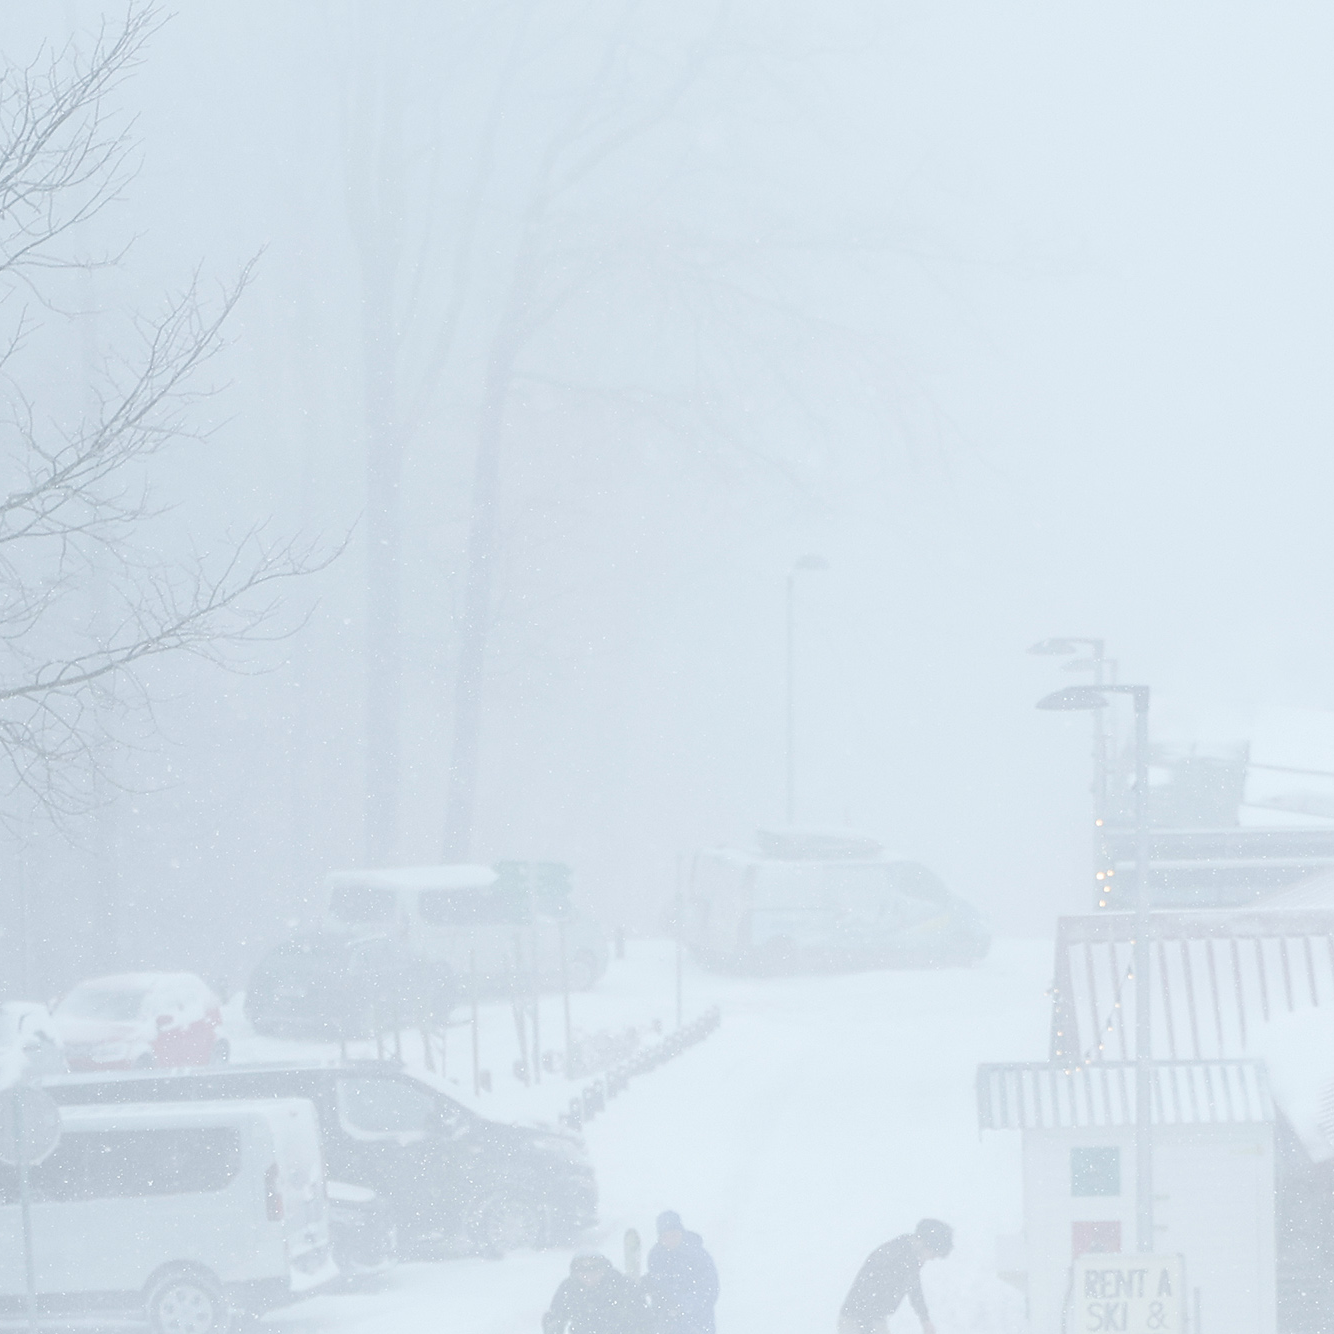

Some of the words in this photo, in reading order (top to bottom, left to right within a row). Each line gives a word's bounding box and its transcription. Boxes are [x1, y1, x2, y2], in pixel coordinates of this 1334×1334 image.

[1085, 1269, 1148, 1299] RENT
[1157, 1267, 1172, 1297] A
[1087, 1301, 1127, 1331] SKI
[1147, 1301, 1170, 1329] &
